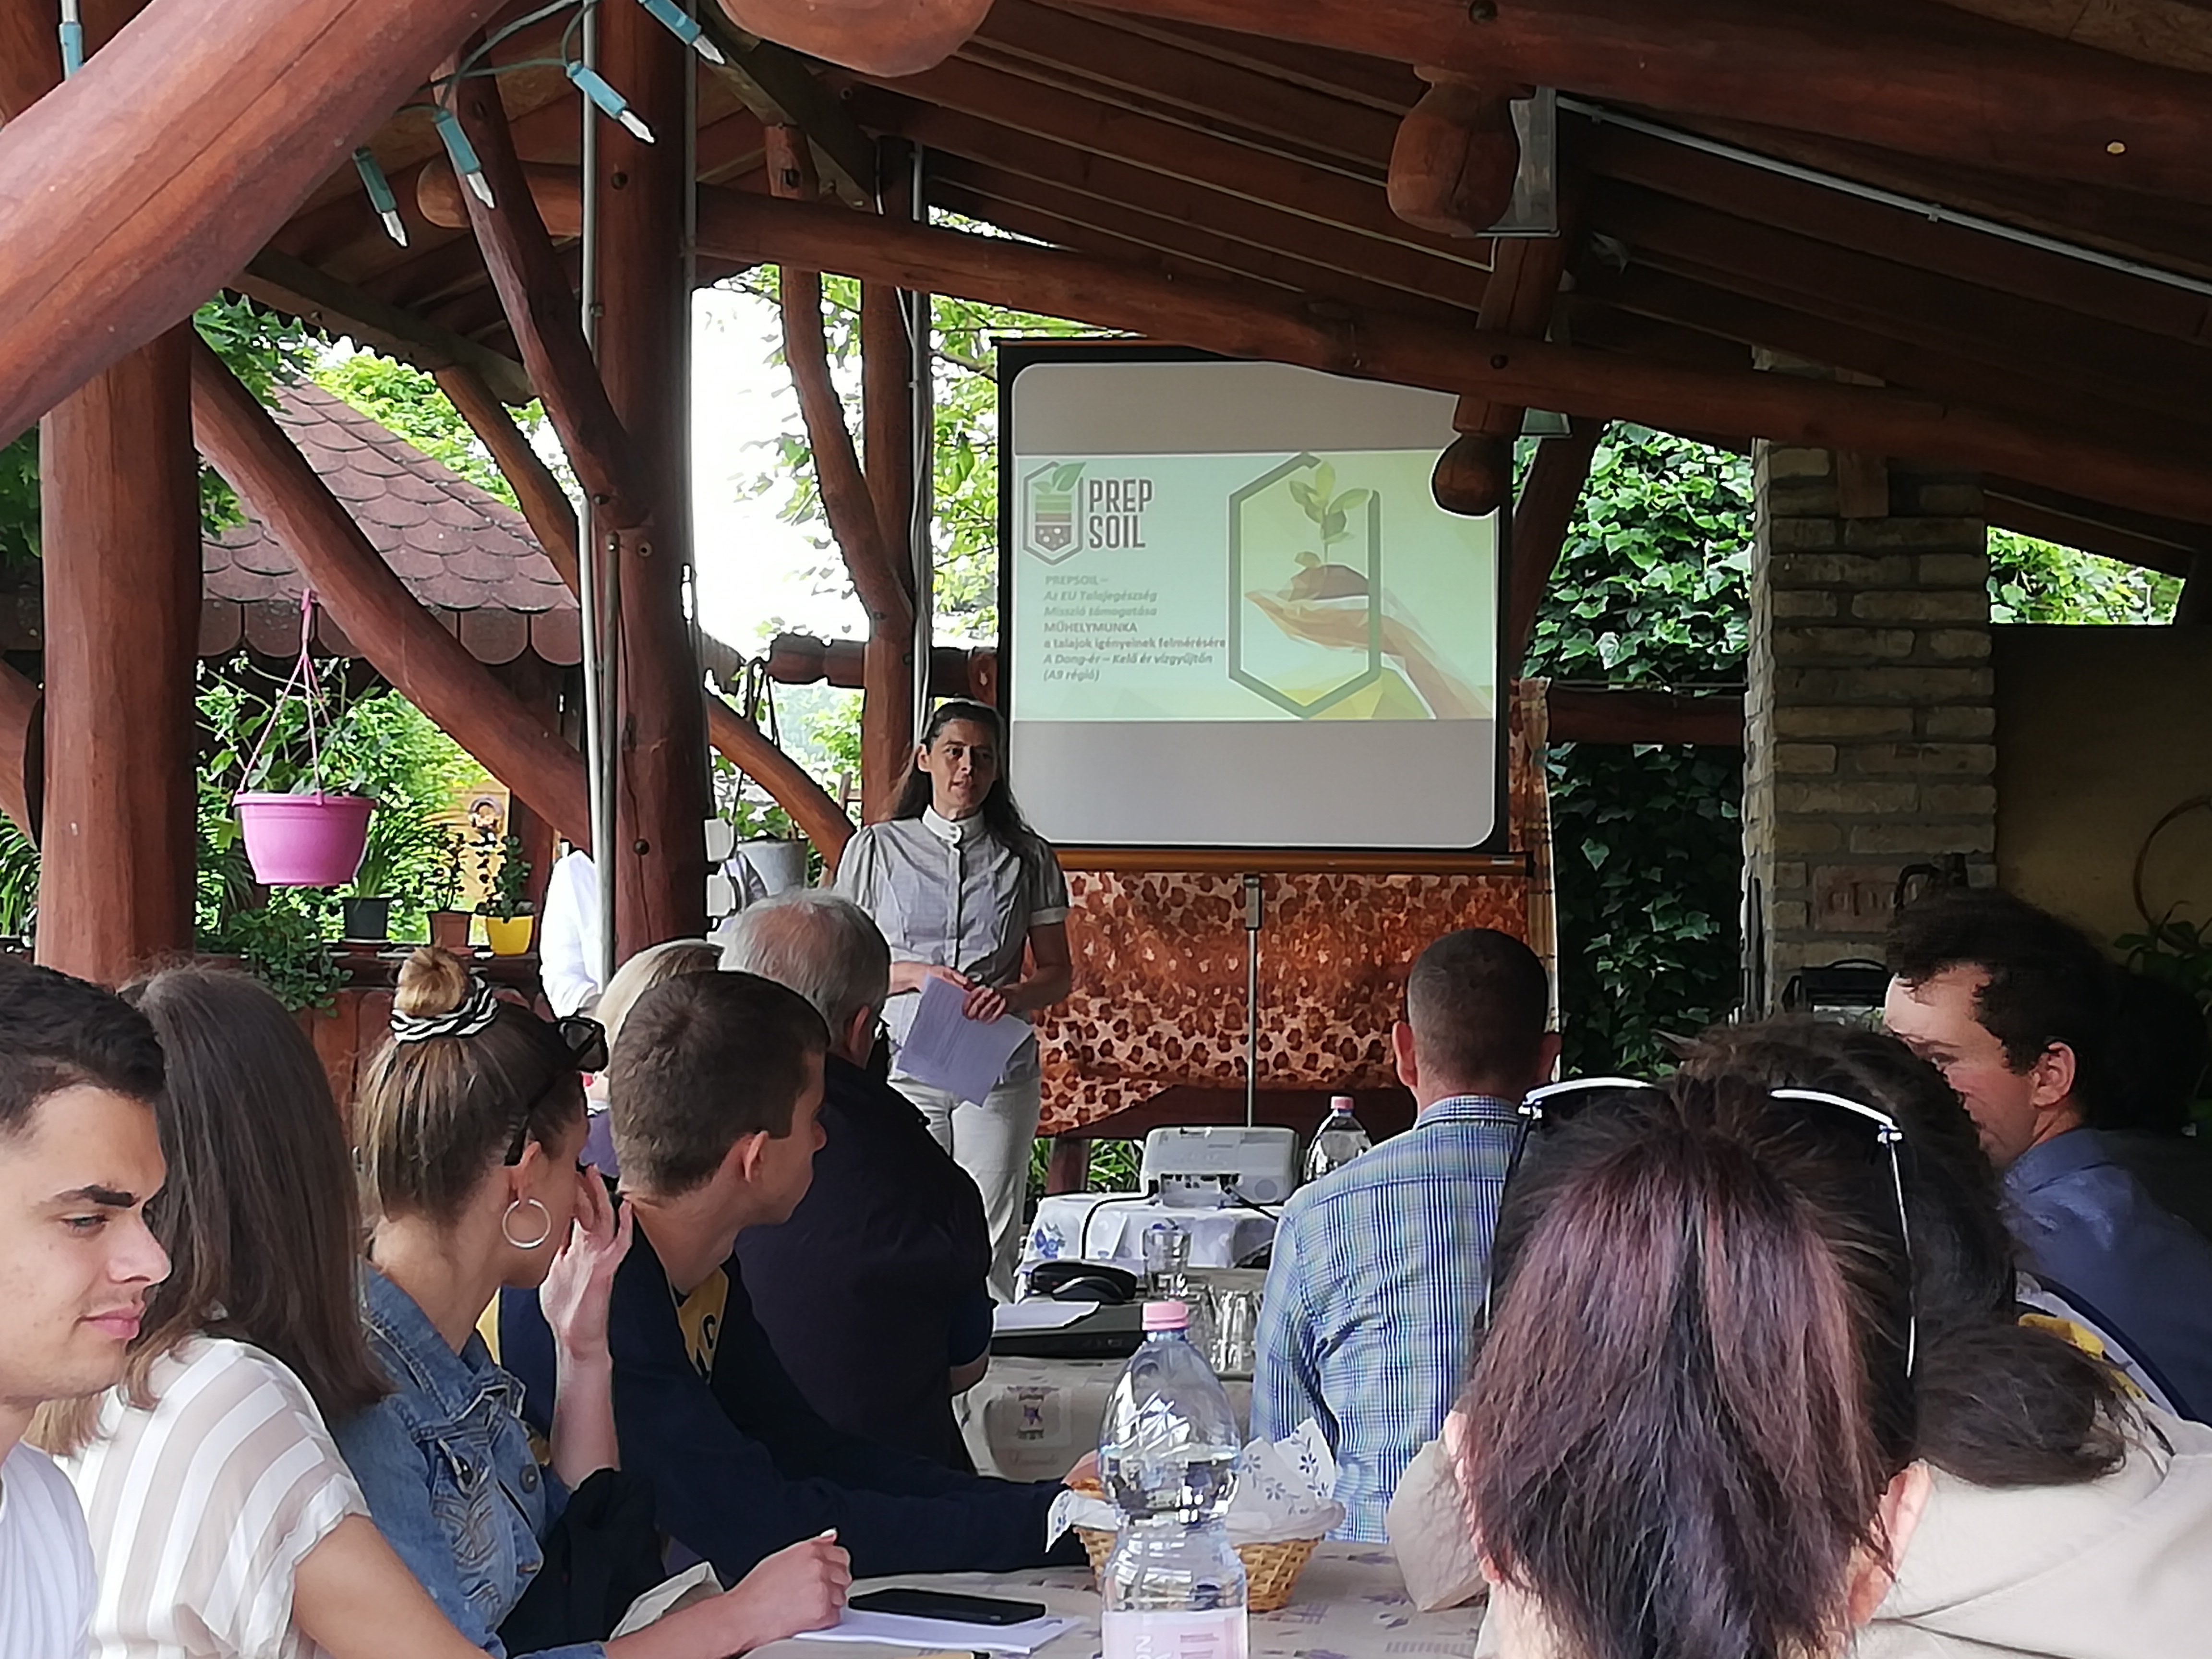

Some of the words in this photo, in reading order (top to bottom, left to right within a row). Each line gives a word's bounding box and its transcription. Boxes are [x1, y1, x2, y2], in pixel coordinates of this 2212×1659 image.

[1088, 479, 1153, 513] PREP
[1088, 515, 1146, 549] SOIL
[1045, 576, 1098, 585] PREPSOIL
[1043, 590, 1058, 601] Az
[1061, 590, 1077, 601] EU
[1080, 589, 1157, 602] Talajegészség
[1044, 605, 1085, 616] Misszió
[1089, 605, 1157, 618] támogatása
[1054, 637, 1092, 650] talajok
[1095, 637, 1155, 650] igényeinek
[1158, 637, 1226, 649] felmérésére
[1043, 653, 1052, 664] A
[1055, 653, 1100, 666] Dong-ér
[1140, 653, 1152, 664] ér
[1066, 669, 1100, 682] régió)
